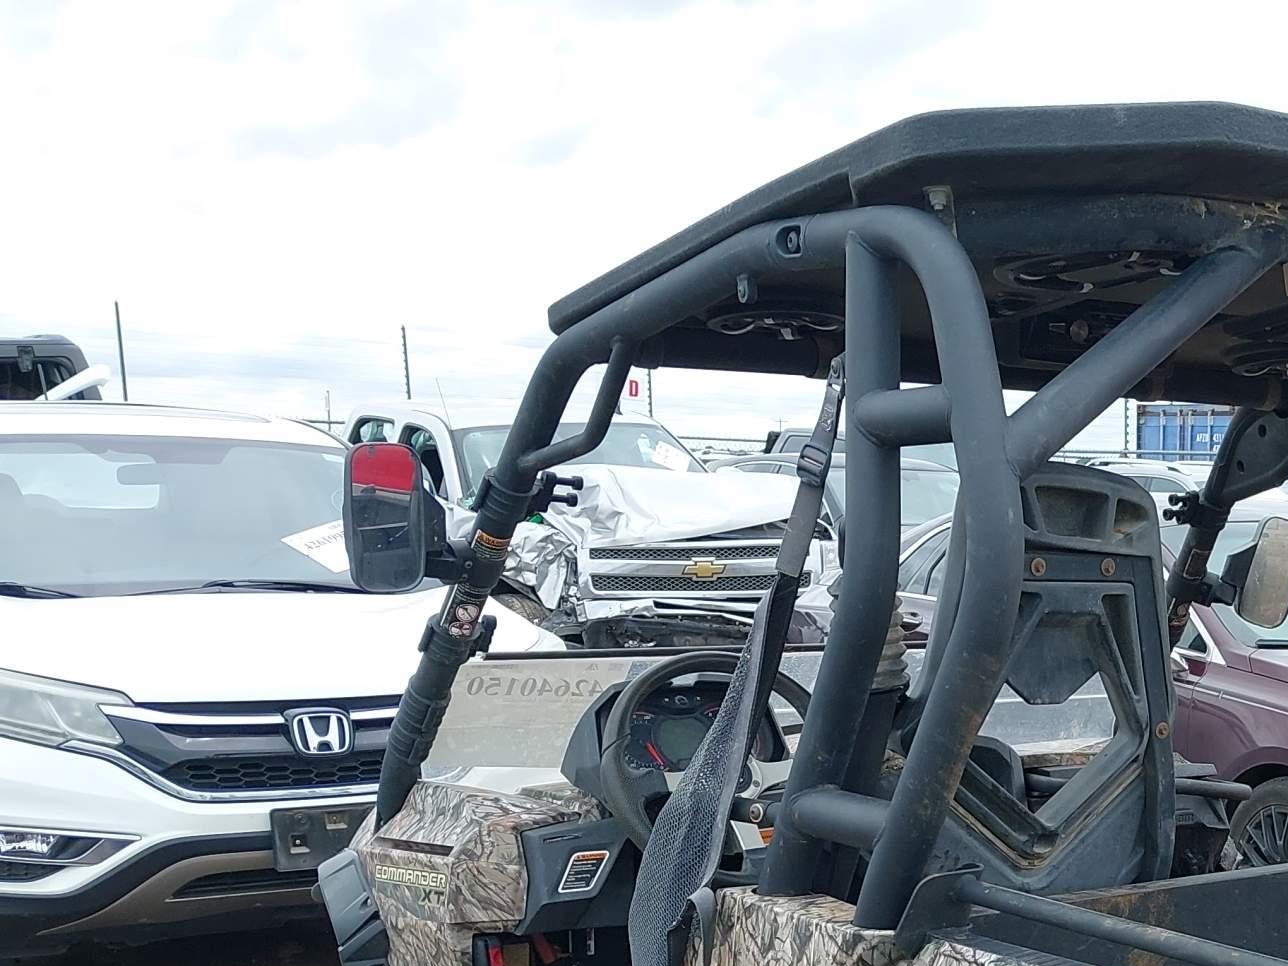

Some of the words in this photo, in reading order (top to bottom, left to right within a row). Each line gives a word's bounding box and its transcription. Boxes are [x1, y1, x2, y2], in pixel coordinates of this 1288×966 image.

[629, 379, 639, 397] D
[375, 865, 446, 888] COMMANDER
[420, 889, 445, 905] XT
